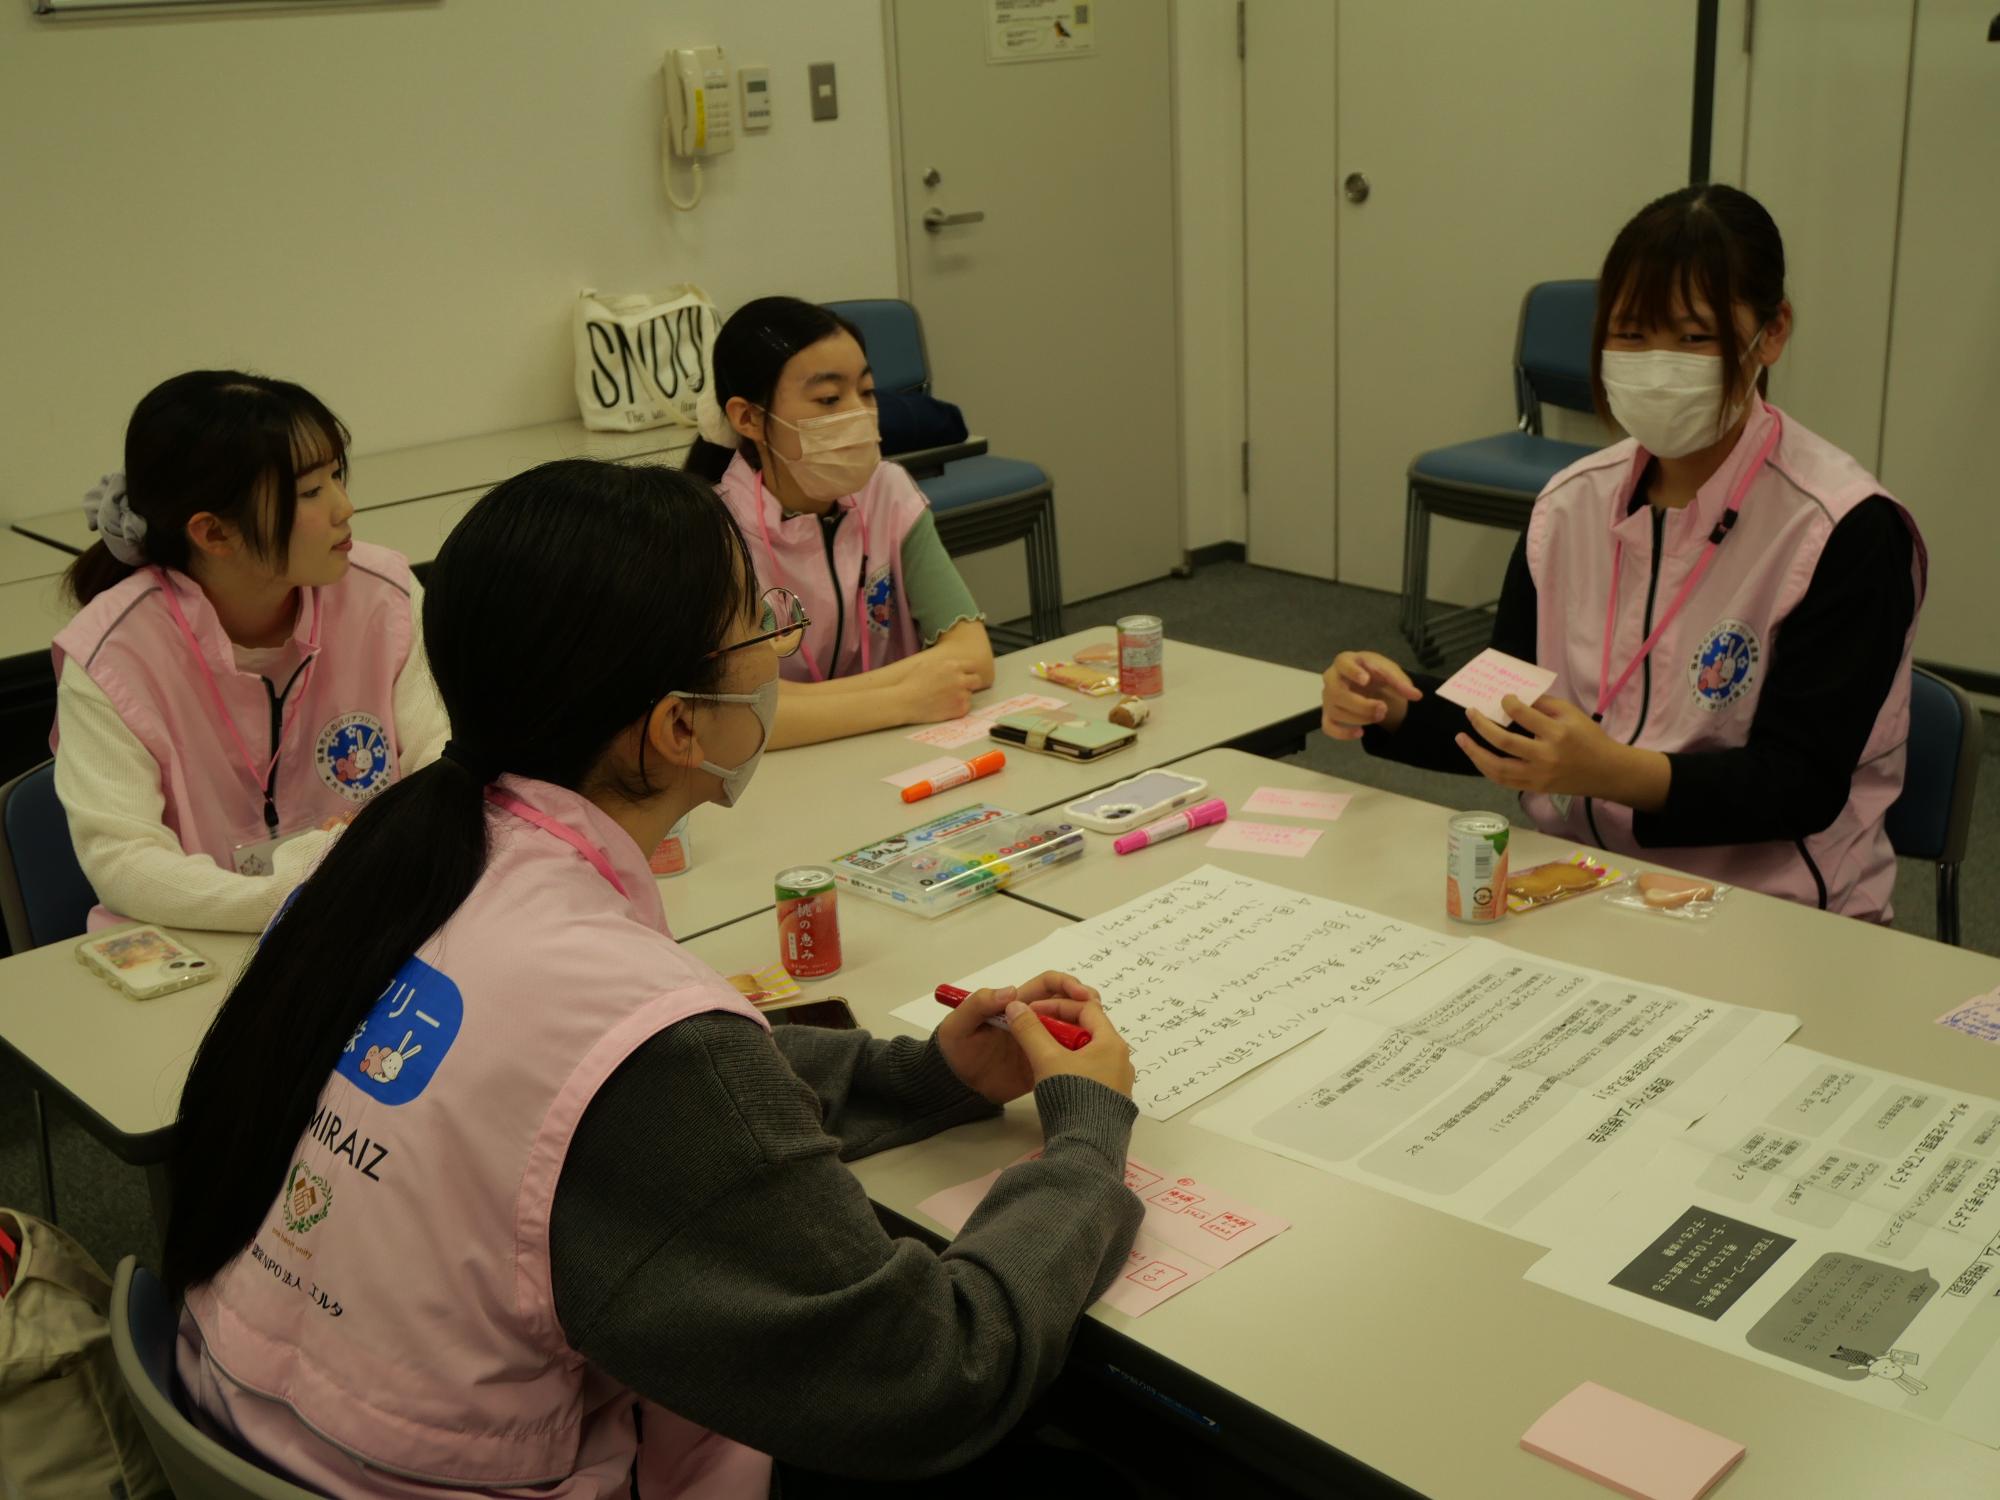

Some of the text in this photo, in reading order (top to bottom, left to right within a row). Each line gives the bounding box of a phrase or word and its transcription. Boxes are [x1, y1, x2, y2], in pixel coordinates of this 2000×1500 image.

[309, 1104, 388, 1182] MIRAIZ
[308, 1282, 343, 1317] エルタ
